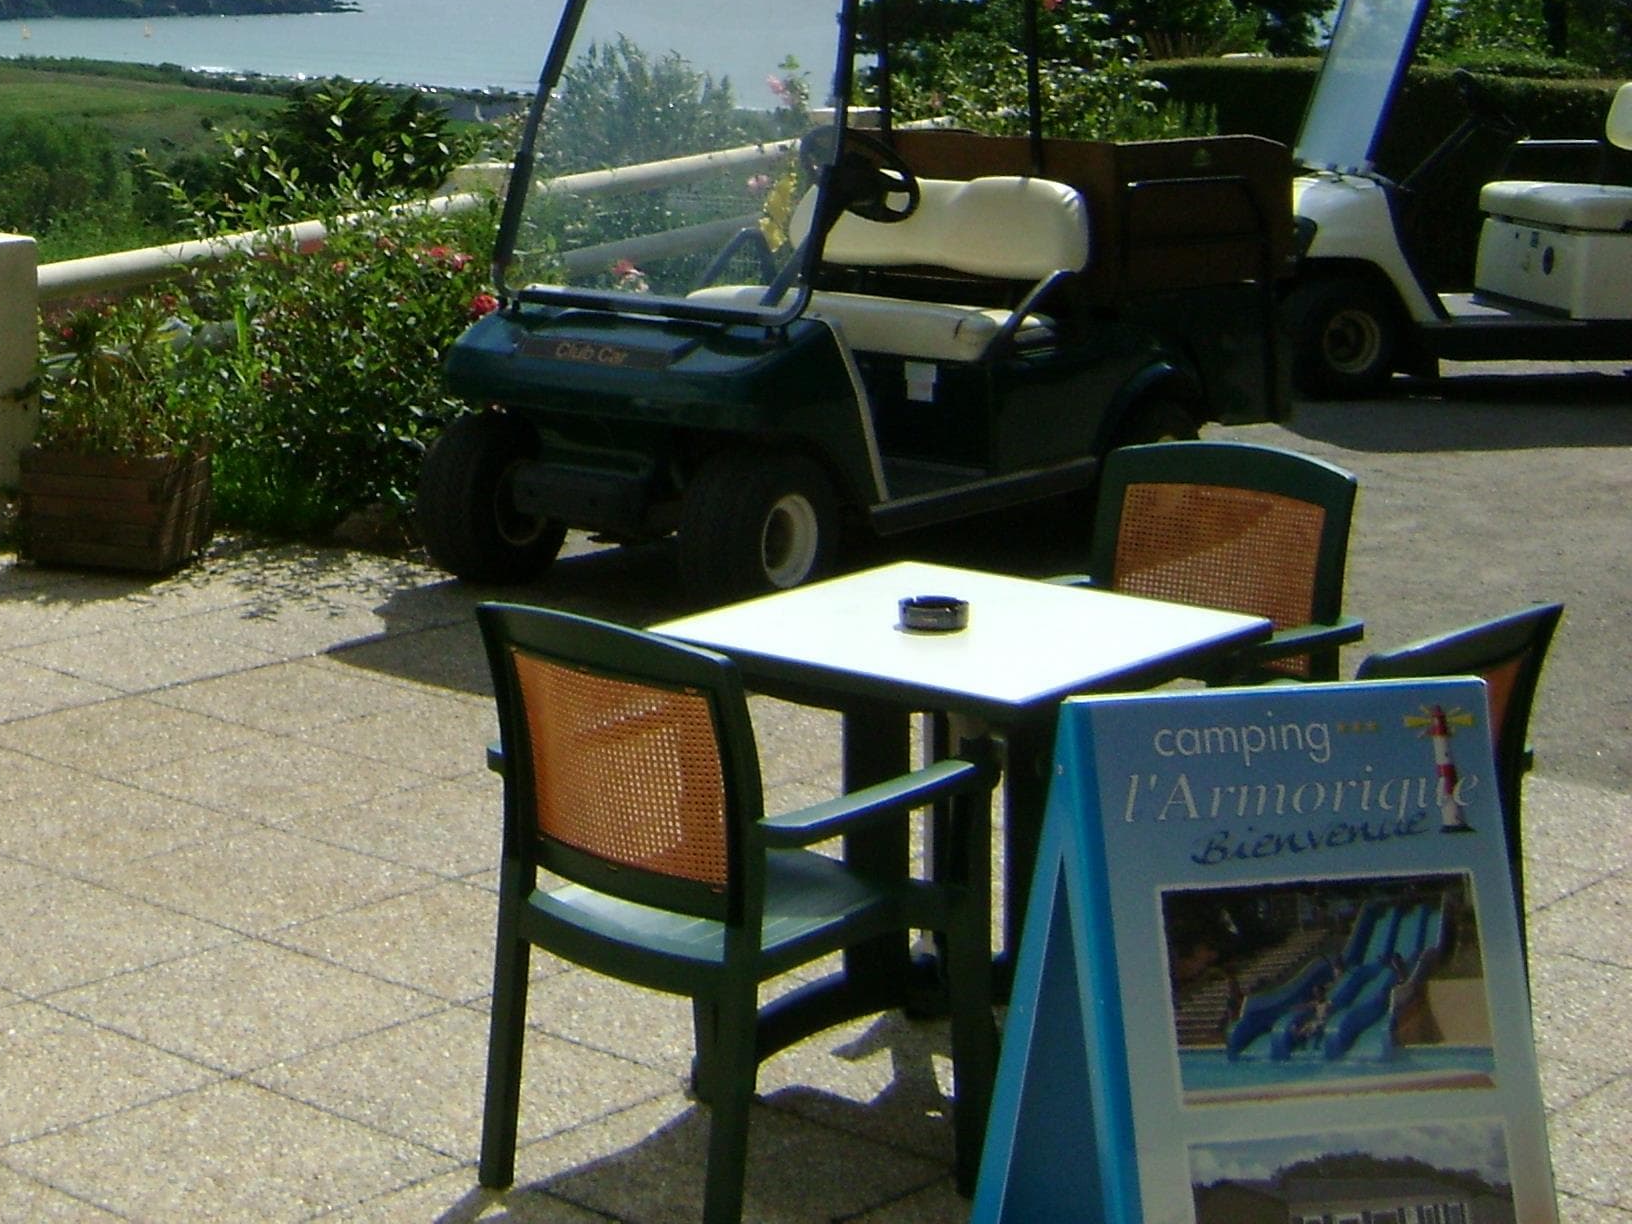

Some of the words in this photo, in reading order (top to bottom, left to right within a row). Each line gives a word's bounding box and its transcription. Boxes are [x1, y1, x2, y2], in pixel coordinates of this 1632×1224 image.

[555, 341, 594, 361] Club
[598, 347, 628, 364] Car
[1153, 710, 1331, 767] camping
[1124, 764, 1479, 824] l'Armorique
[1189, 810, 1430, 866] Bienvenue
